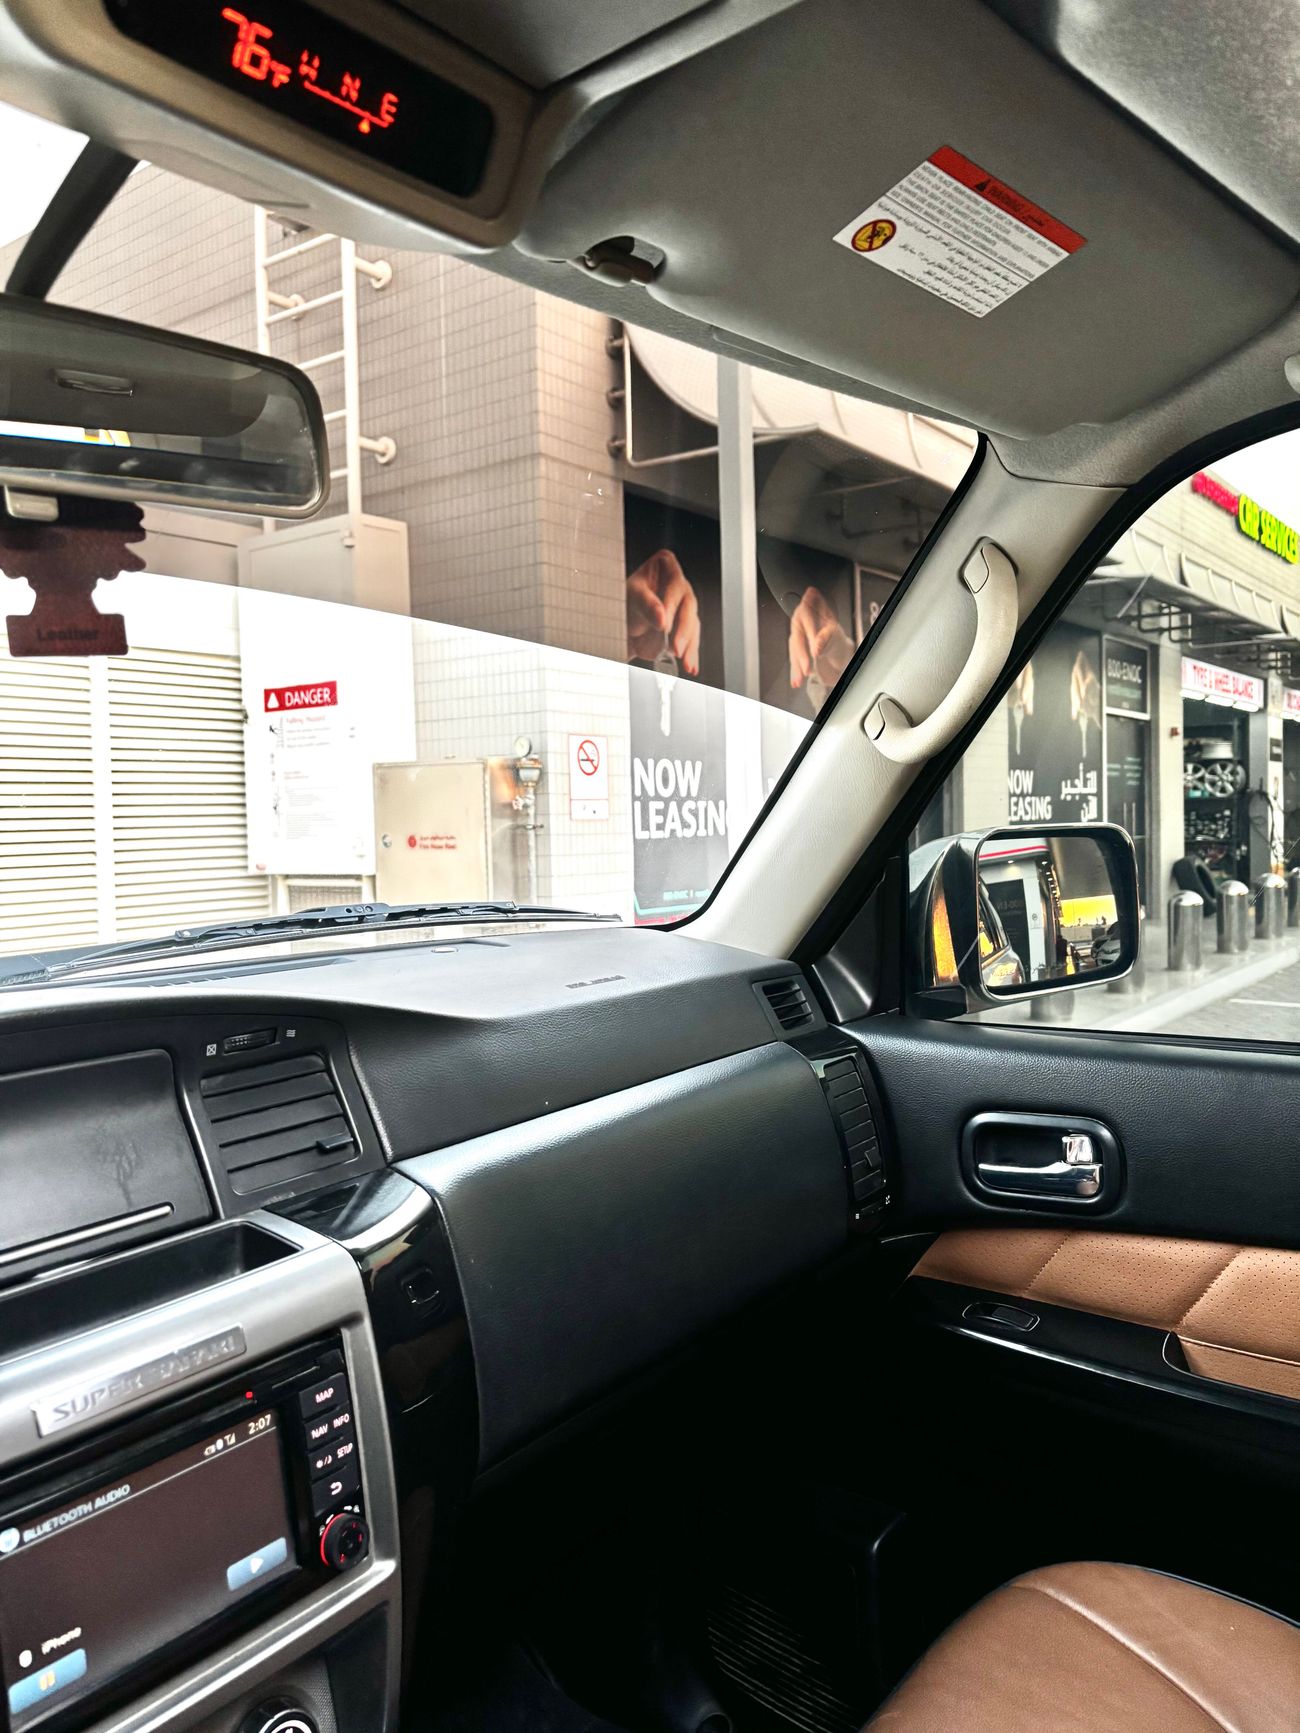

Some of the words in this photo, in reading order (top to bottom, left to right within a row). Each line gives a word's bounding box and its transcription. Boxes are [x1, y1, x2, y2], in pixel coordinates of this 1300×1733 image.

[381, 92, 399, 124] E
[285, 687, 331, 707] DANGER
[633, 757, 703, 798] NOW
[633, 799, 729, 840] LEASIN
[315, 1387, 334, 1403] MAP
[248, 1413, 272, 1435] 2:07
[311, 1423, 328, 1439] NAV
[333, 1413, 350, 1428] INFO
[336, 1442, 353, 1459] SETUP
[23, 1501, 93, 1543] BLUETOOTH
[94, 1484, 130, 1509] AUDIO
